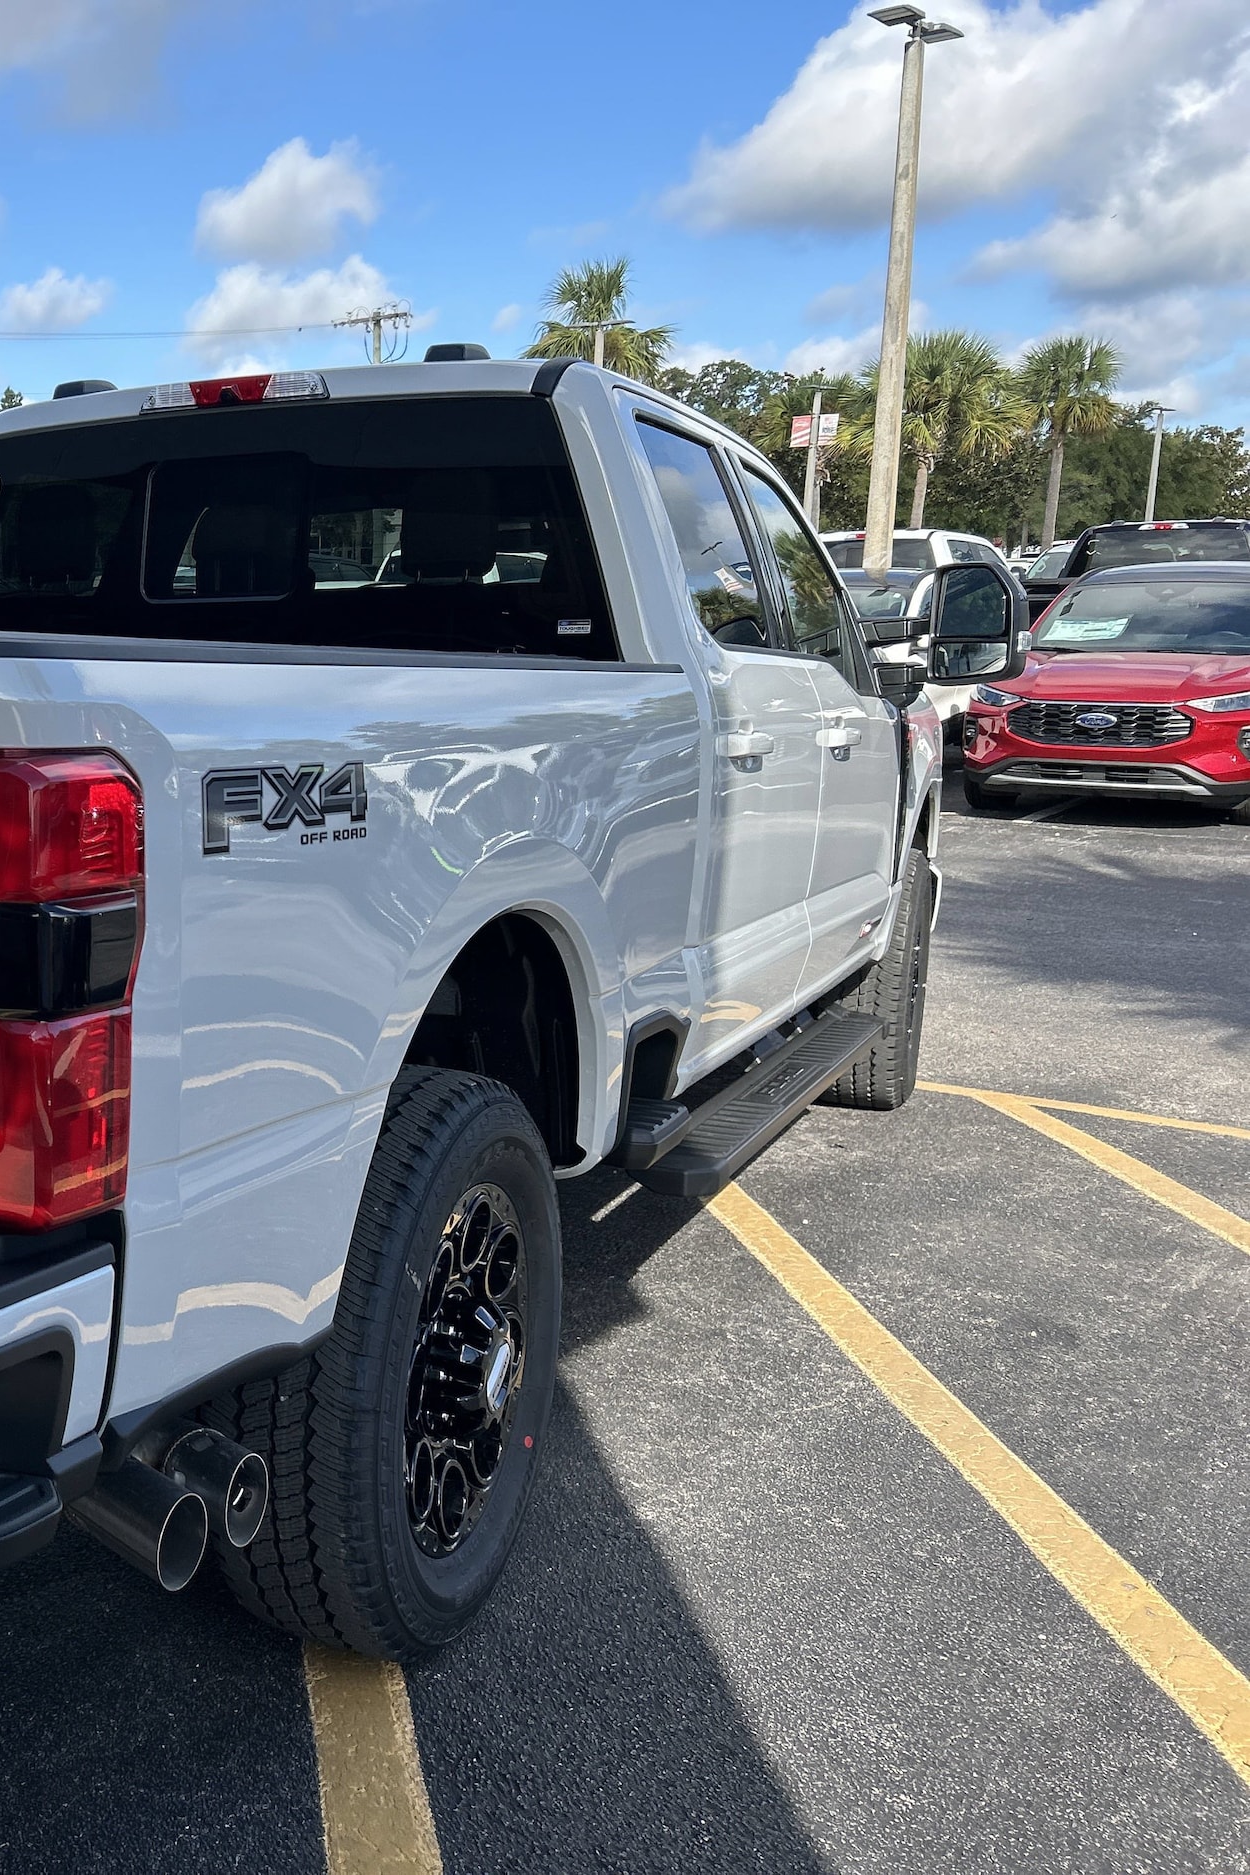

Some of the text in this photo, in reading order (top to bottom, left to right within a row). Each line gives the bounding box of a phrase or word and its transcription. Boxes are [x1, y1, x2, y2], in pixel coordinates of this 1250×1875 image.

[202, 760, 367, 856] FX4
[300, 827, 367, 845] OFF ROAD
